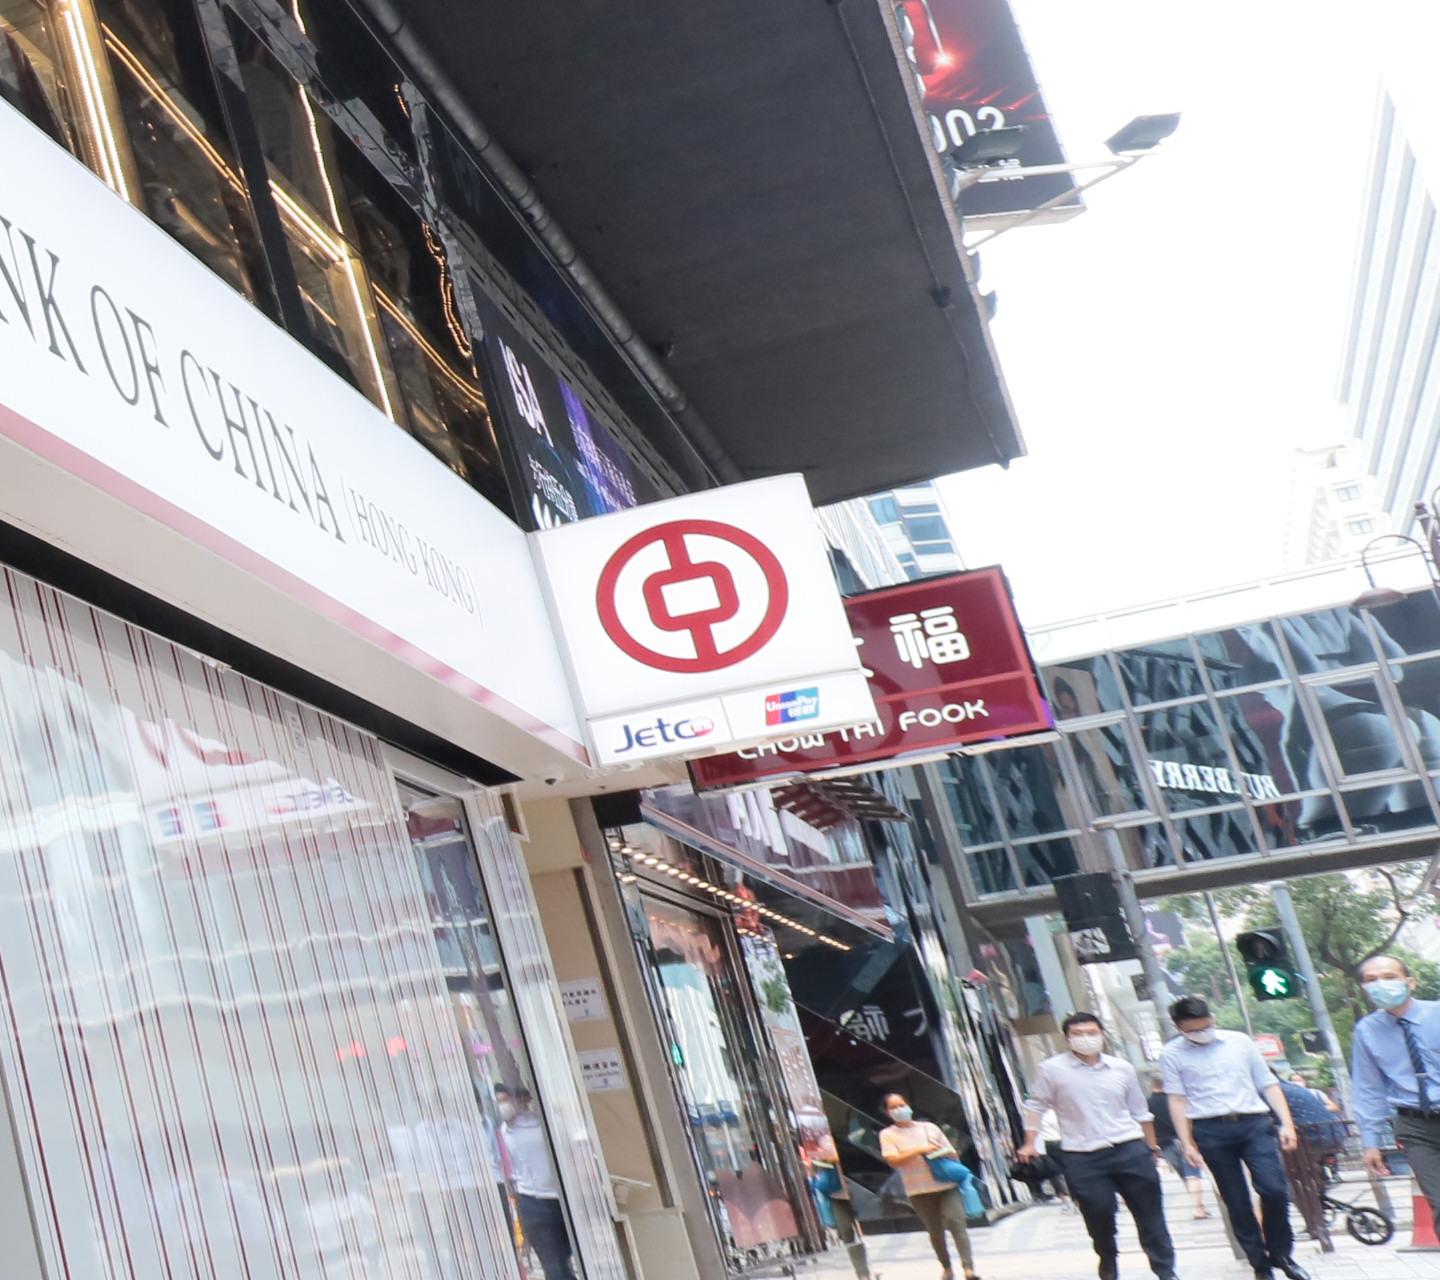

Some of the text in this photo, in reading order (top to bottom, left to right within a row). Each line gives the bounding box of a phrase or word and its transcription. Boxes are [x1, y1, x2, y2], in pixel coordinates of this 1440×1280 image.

[90, 284, 172, 430] OF
[179, 348, 347, 545] CHINA
[898, 699, 990, 732] FOOK
